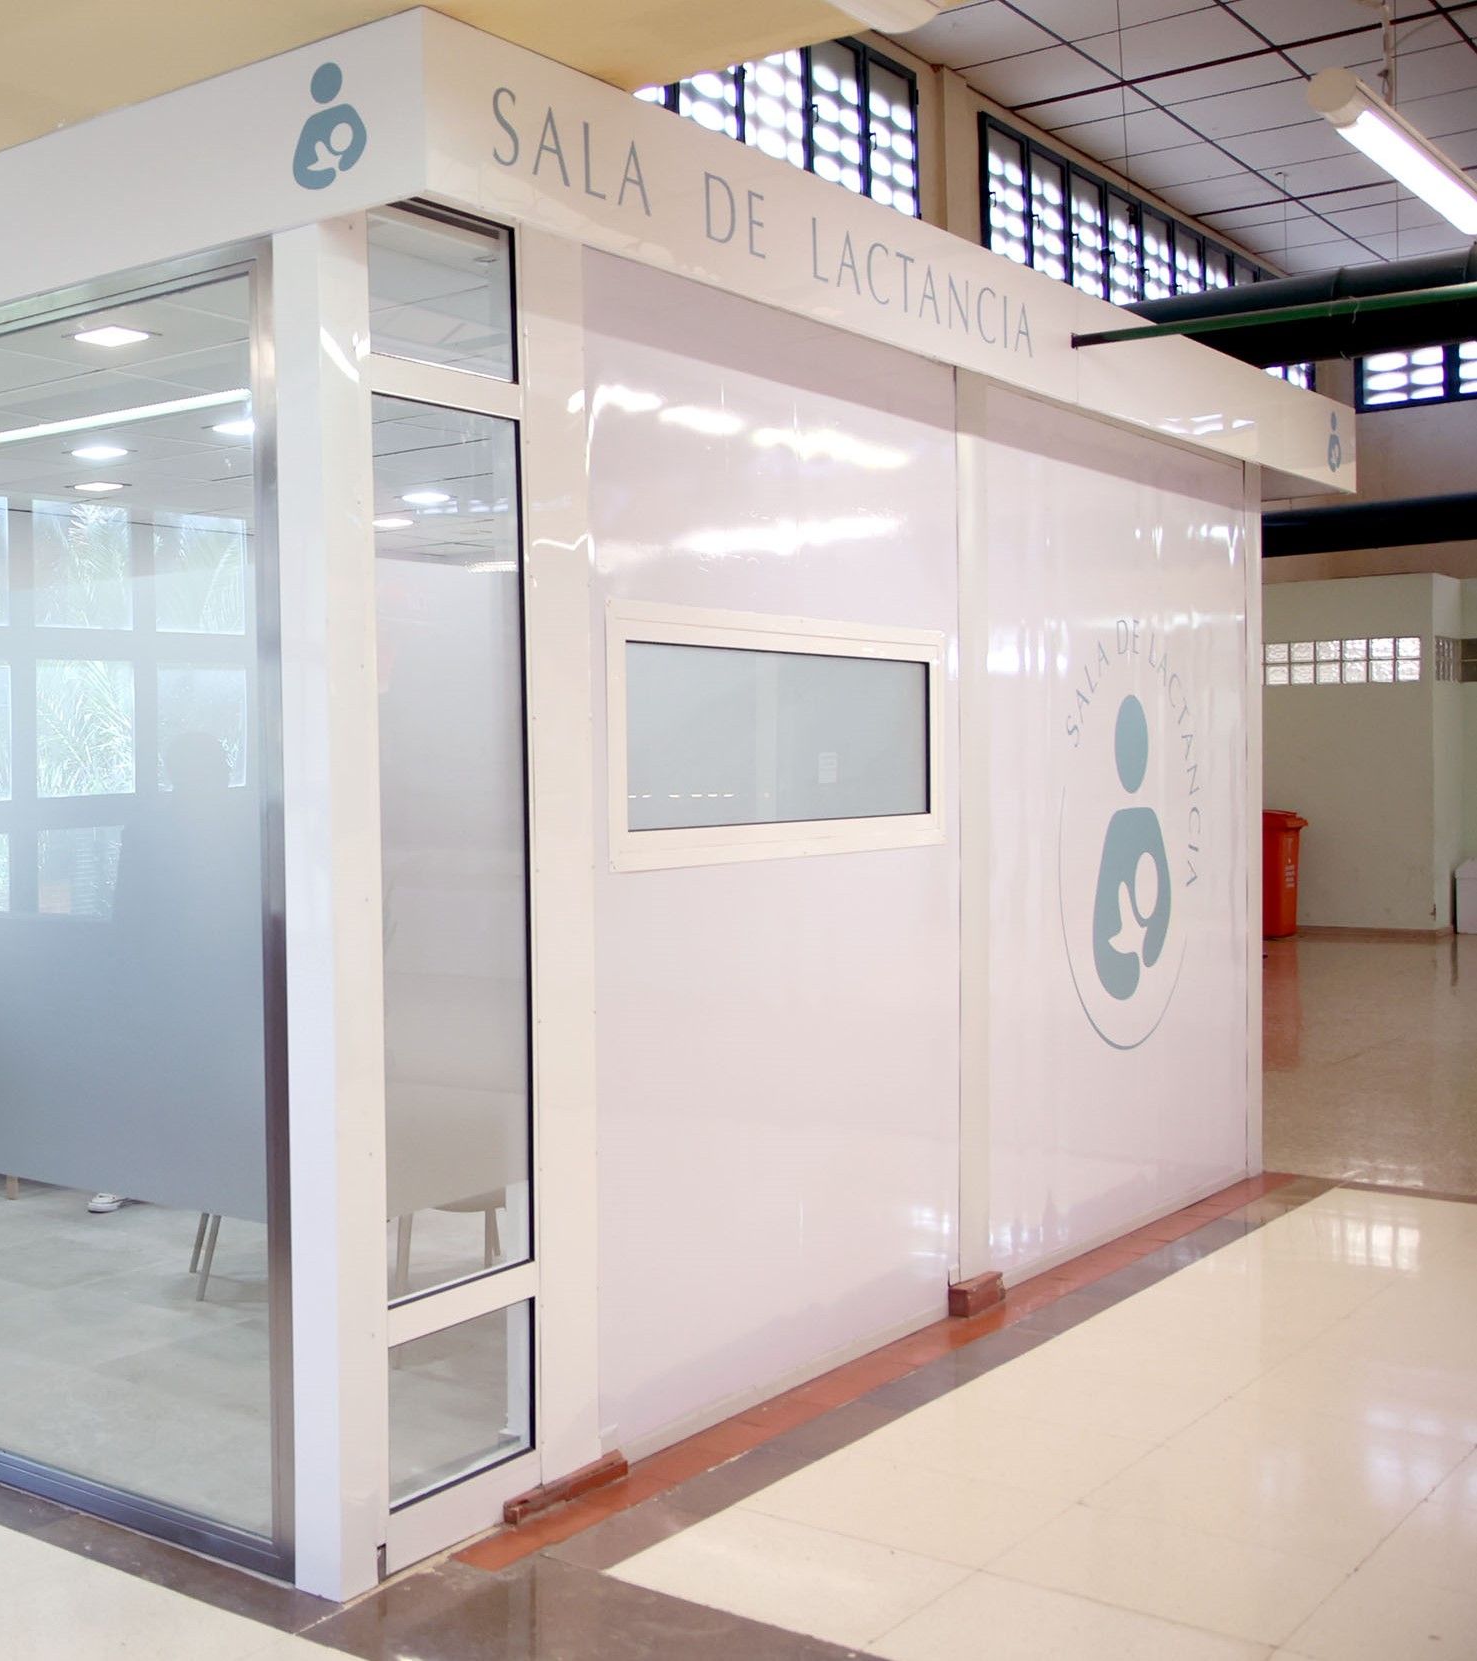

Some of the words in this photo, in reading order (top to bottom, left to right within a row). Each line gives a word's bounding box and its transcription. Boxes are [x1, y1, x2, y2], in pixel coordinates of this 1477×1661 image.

[491, 86, 652, 217] SALA
[703, 171, 766, 260] DE
[811, 216, 1034, 358] LACTANCIA
[1064, 641, 1110, 747] SALA
[1116, 619, 1140, 655] DE
[1148, 632, 1201, 887] LACTANCIA
